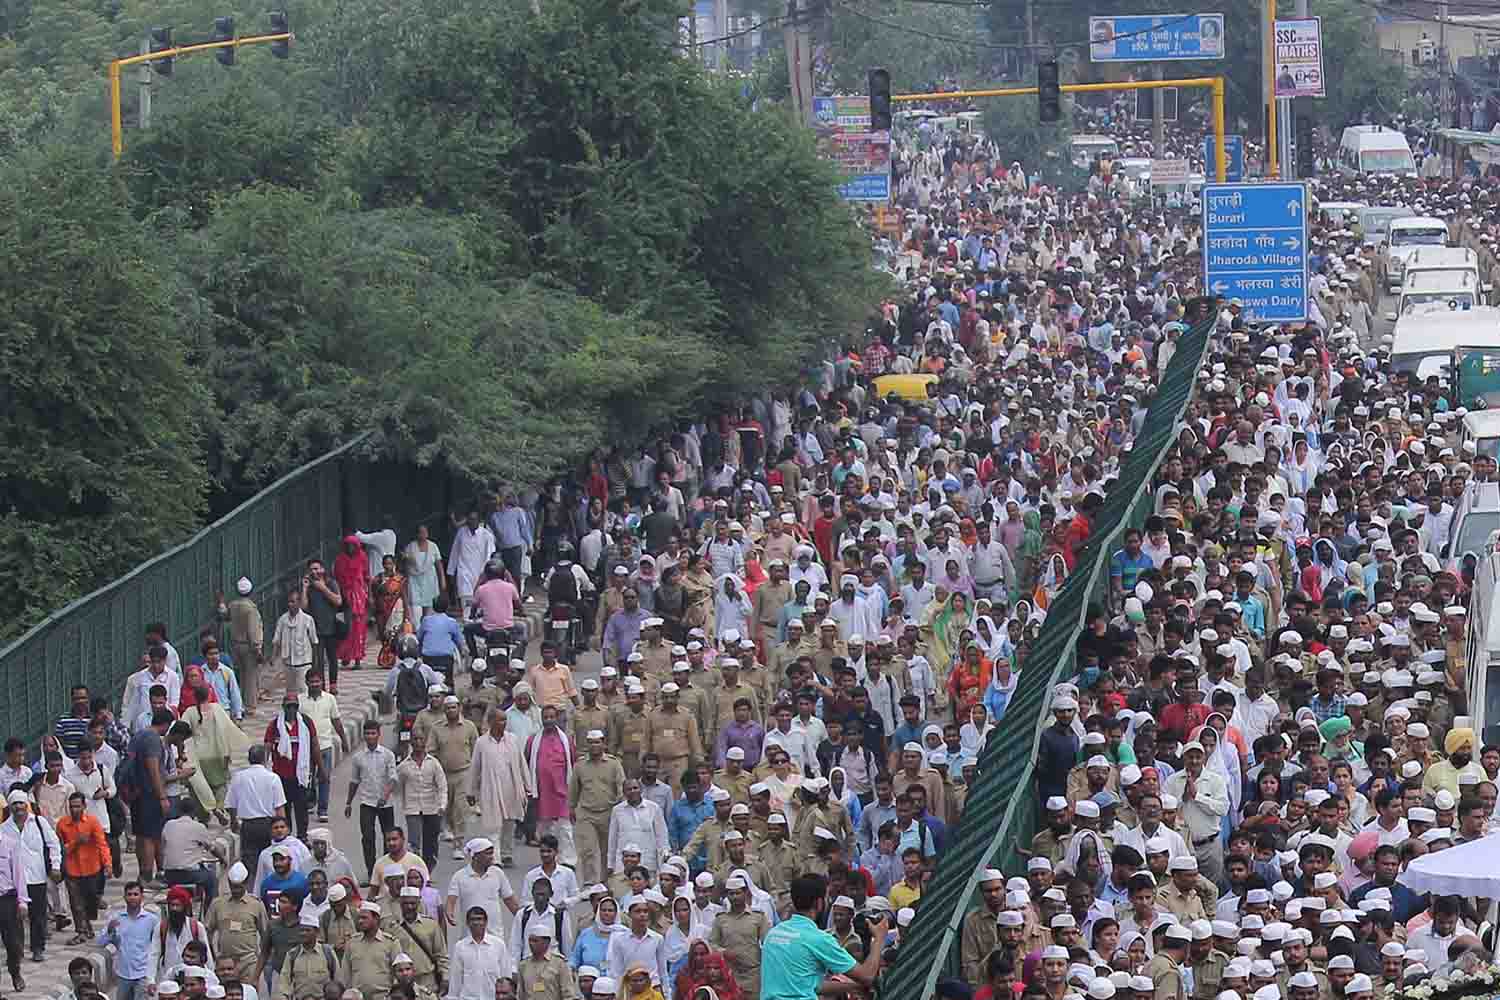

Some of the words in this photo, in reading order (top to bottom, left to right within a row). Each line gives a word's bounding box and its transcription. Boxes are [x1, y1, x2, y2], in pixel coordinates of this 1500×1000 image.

[1277, 30, 1297, 43] SSC
[1279, 45, 1317, 57] MATHS
[1208, 213, 1245, 224] Burari
[1209, 255, 1258, 265] Jharoda
[1262, 254, 1301, 266] Village
[1271, 296, 1302, 307] Dairy
